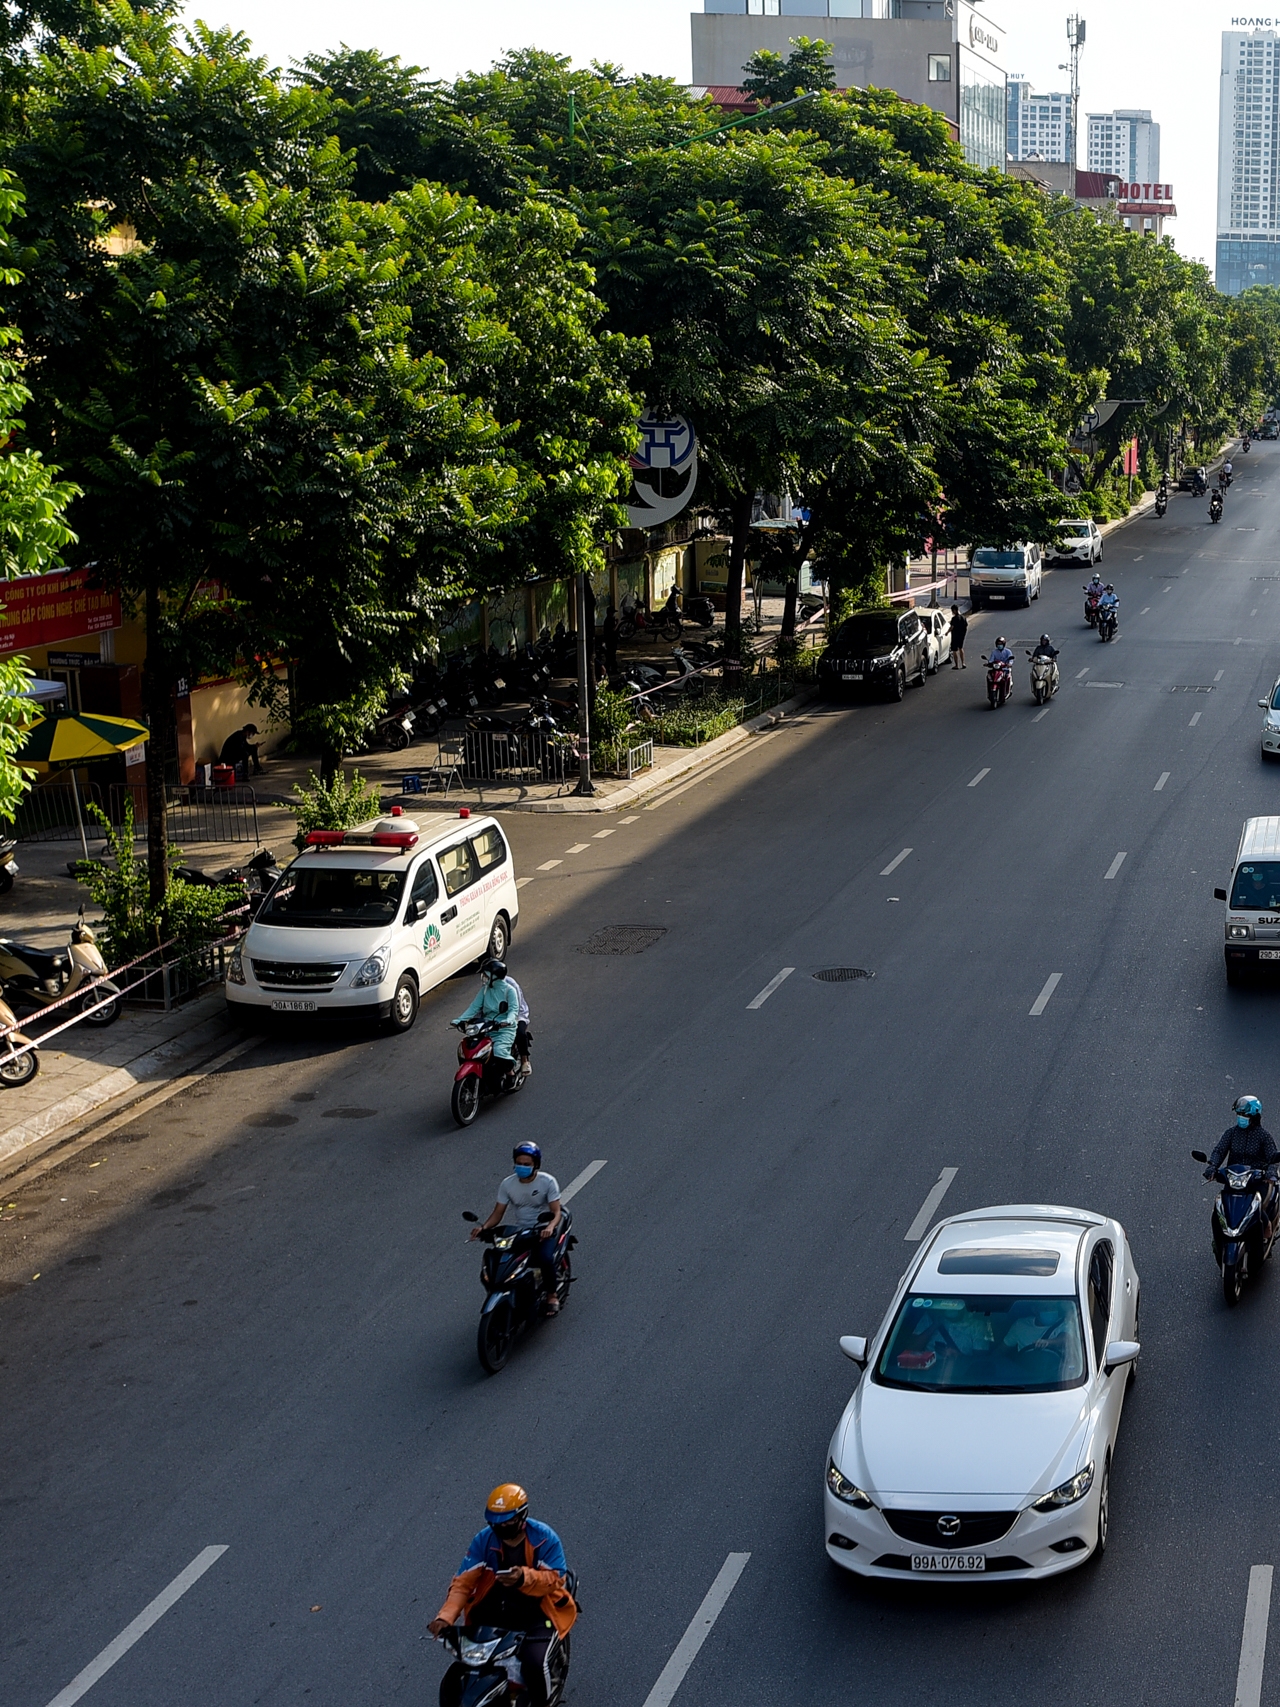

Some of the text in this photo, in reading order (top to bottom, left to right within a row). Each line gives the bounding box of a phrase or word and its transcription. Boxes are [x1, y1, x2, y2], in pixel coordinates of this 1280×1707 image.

[1231, 17, 1272, 26] HOANG
[1118, 182, 1172, 200] HOTEL
[5, 587, 24, 601] CÔNG
[26, 586, 35, 598] TY
[36, 583, 46, 596] CƠ
[47, 580, 59, 594] KHÍ
[22, 604, 36, 623] CẤP
[37, 602, 55, 621] CÔNG
[56, 598, 73, 618] NGHỆ
[74, 593, 87, 614] CHẾ
[88, 595, 99, 613] TẠO
[913, 1556, 984, 1570] 99A-076.92
